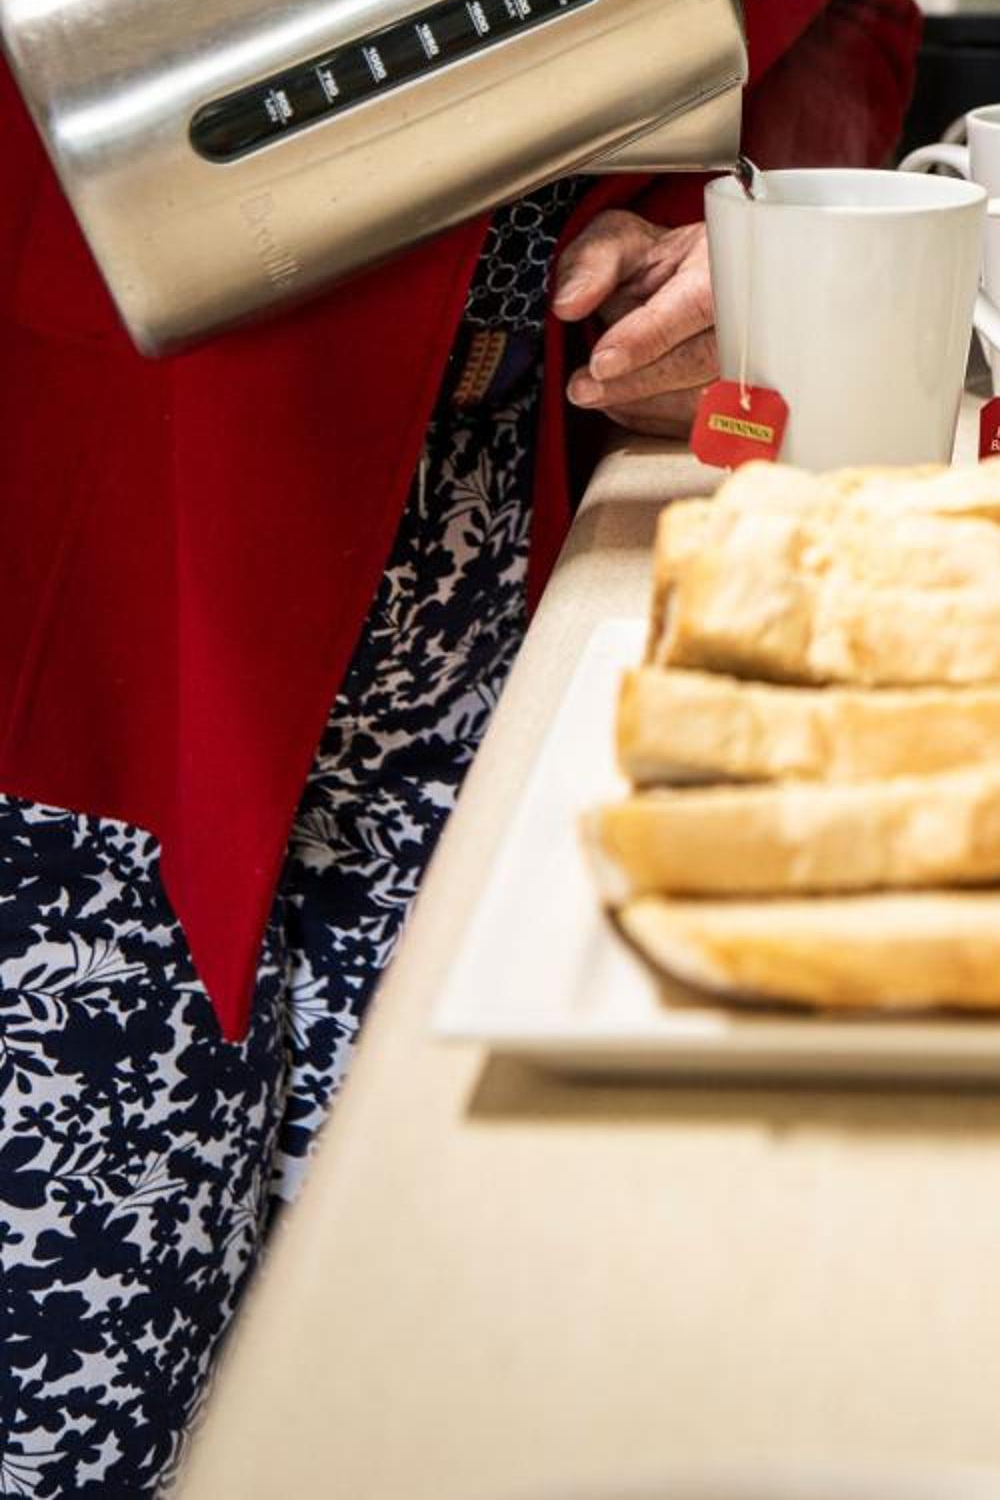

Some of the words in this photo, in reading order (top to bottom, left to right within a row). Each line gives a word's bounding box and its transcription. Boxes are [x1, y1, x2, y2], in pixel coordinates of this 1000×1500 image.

[470, 0, 490, 33] 1500
[420, 23, 439, 55] 1250
[368, 46, 387, 79] 1000
[321, 69, 339, 98] 750
[275, 90, 293, 118] 500
